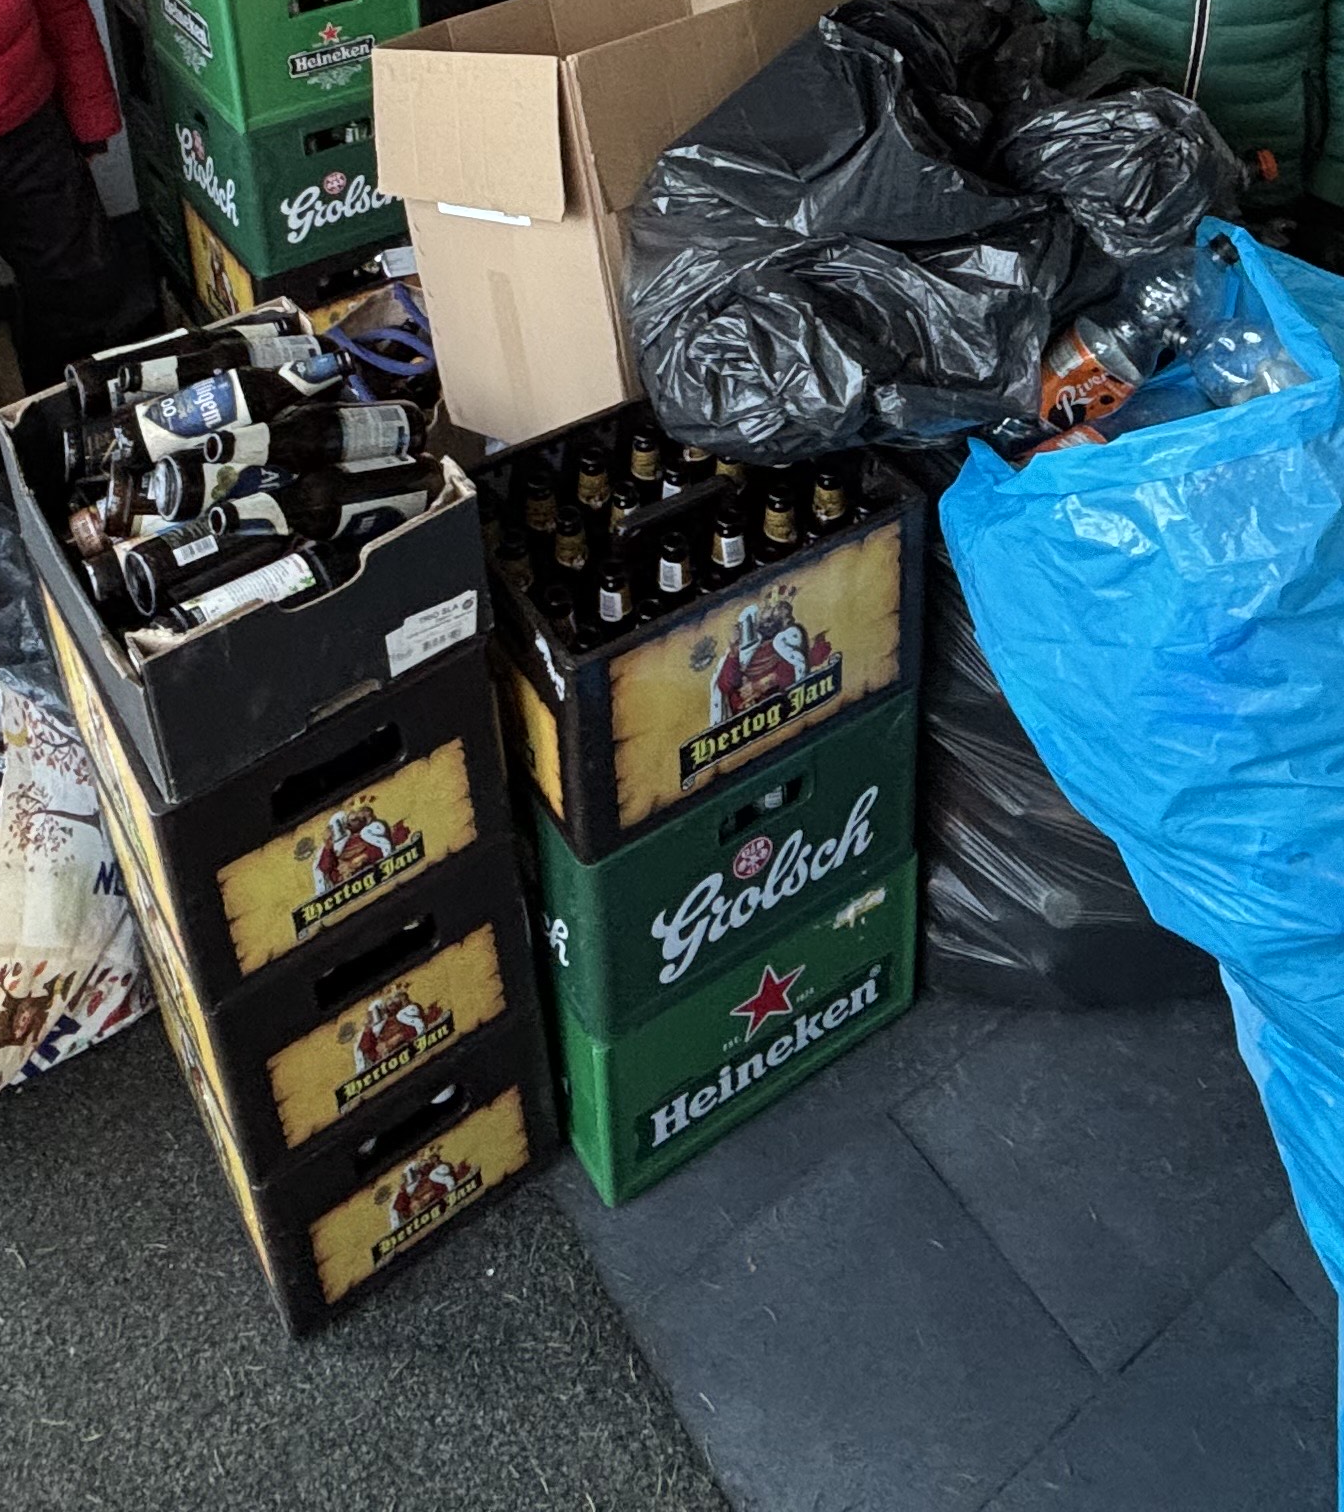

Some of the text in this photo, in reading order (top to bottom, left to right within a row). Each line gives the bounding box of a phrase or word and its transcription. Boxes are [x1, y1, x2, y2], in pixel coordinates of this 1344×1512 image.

[294, 39, 370, 74] Heineken
[175, 122, 240, 227] Grolsch
[689, 673, 835, 770] Hertog Jan
[301, 846, 420, 924] Hertog Jan
[650, 785, 879, 985] Grolsch
[342, 1021, 451, 1101] Hertog Jan
[649, 976, 880, 1148] Heineken
[376, 1178, 478, 1256] Hertog Jan
